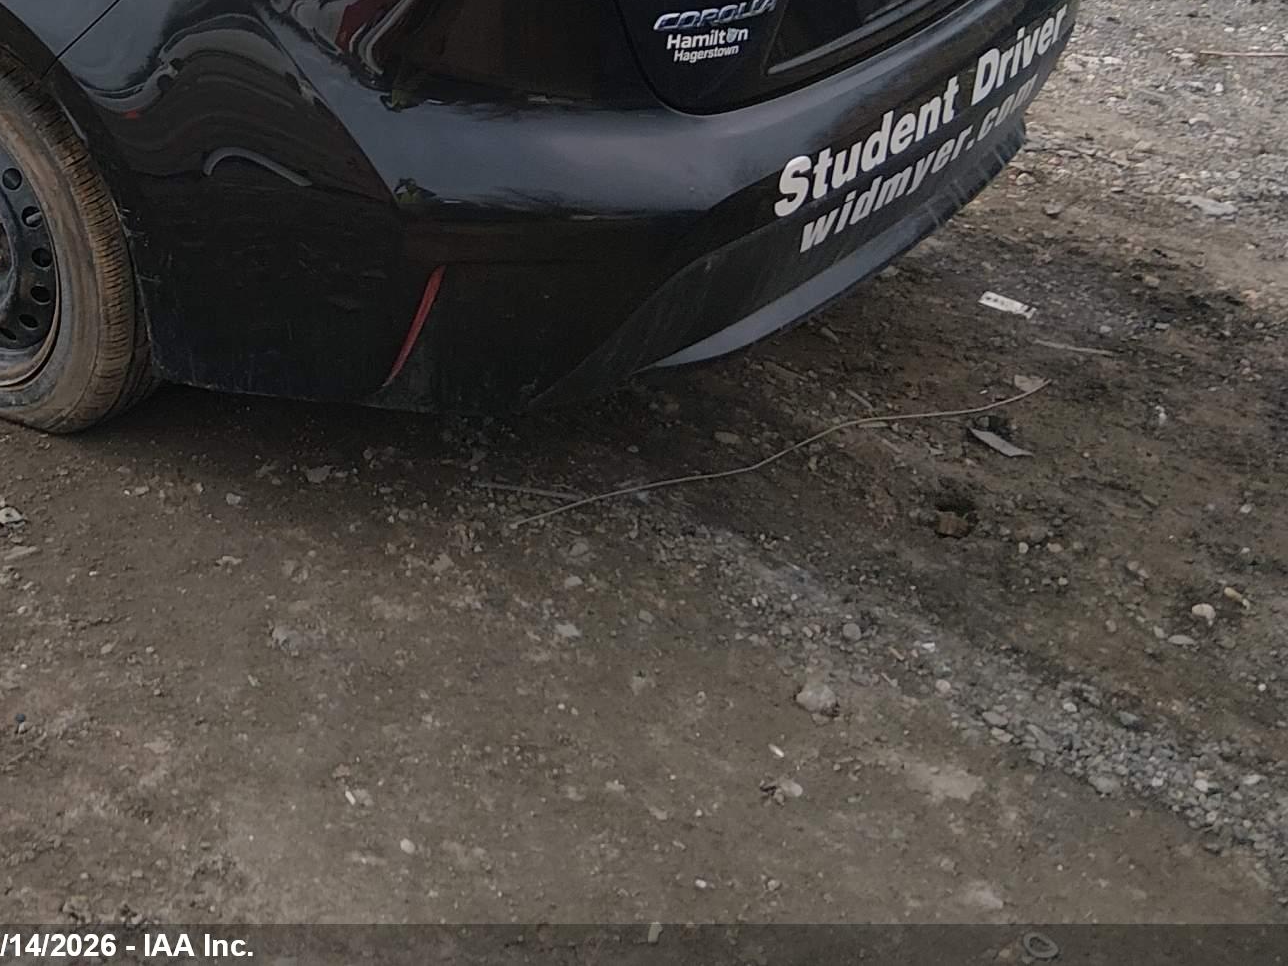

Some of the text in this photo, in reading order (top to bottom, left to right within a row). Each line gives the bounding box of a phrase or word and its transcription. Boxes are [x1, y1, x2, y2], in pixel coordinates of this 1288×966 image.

[674, 45, 739, 63] Hagerstown
[774, 4, 1068, 217] Student Driver
[799, 73, 1039, 253] widmyer.com
